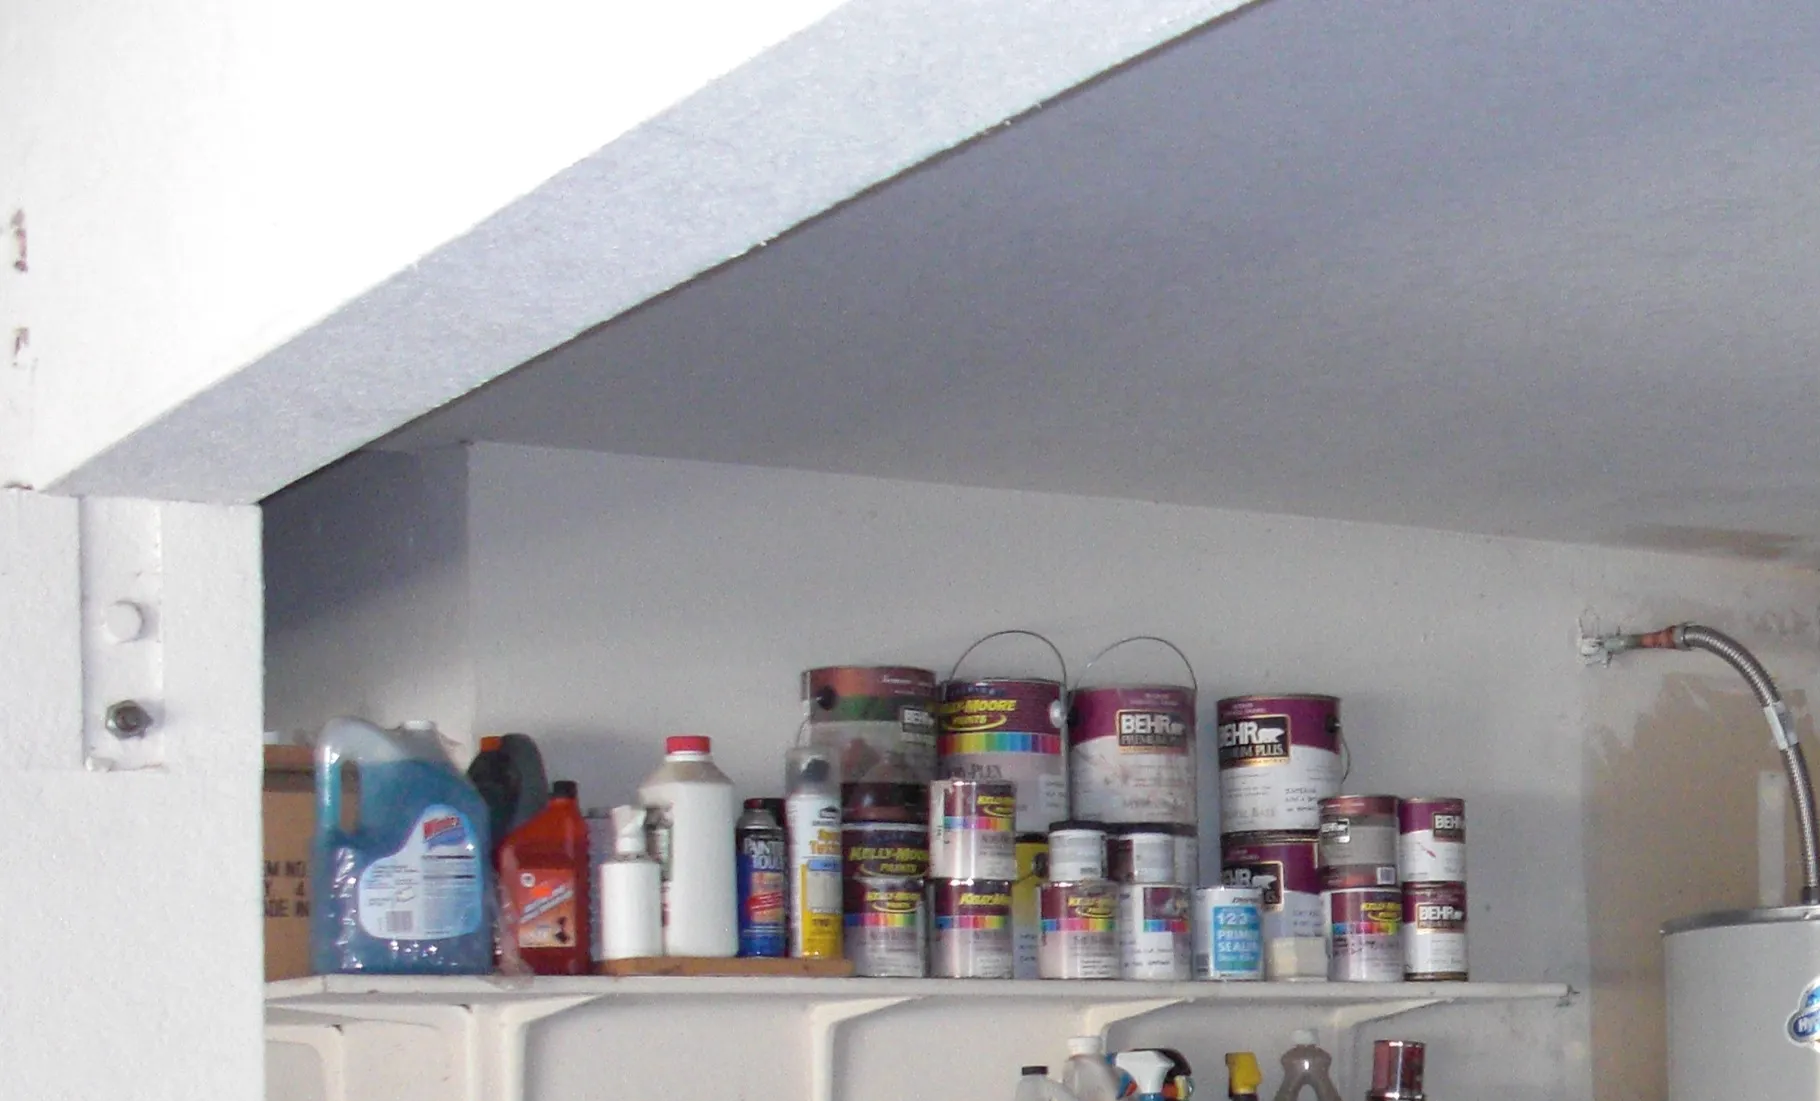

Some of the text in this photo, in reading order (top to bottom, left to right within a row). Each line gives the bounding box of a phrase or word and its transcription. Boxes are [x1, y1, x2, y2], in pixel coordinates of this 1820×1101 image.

[1121, 713, 1170, 734] BEHR
[1256, 744, 1284, 756] PLUS
[1420, 905, 1454, 921] BEHR
